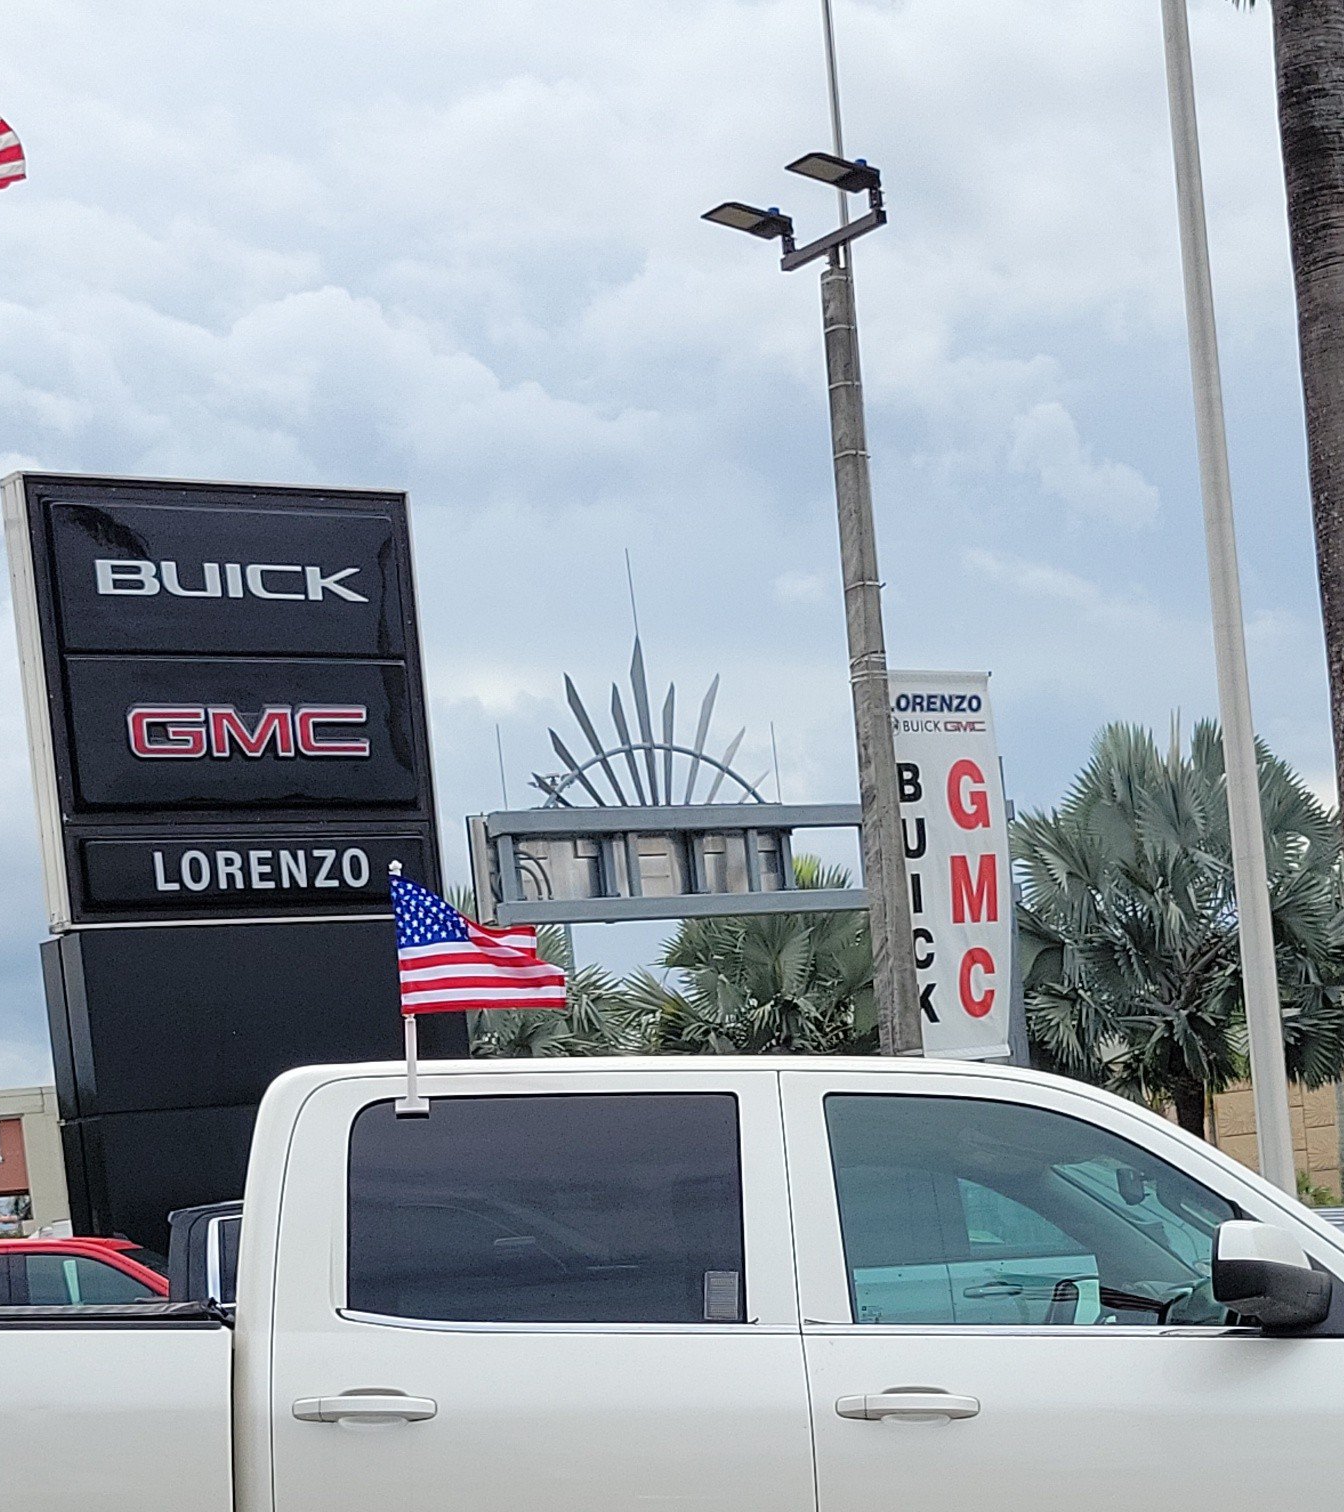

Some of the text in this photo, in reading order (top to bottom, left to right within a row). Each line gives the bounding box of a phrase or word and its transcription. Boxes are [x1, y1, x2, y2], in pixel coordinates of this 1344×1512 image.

[94, 558, 370, 602] BUICK
[891, 693, 982, 713] ORENZO
[127, 704, 371, 758] GMC
[903, 720, 987, 733] BUICK GMC
[153, 848, 371, 892] LORENZO
[946, 758, 999, 1019] GMC
[896, 762, 941, 1024] BUICK
